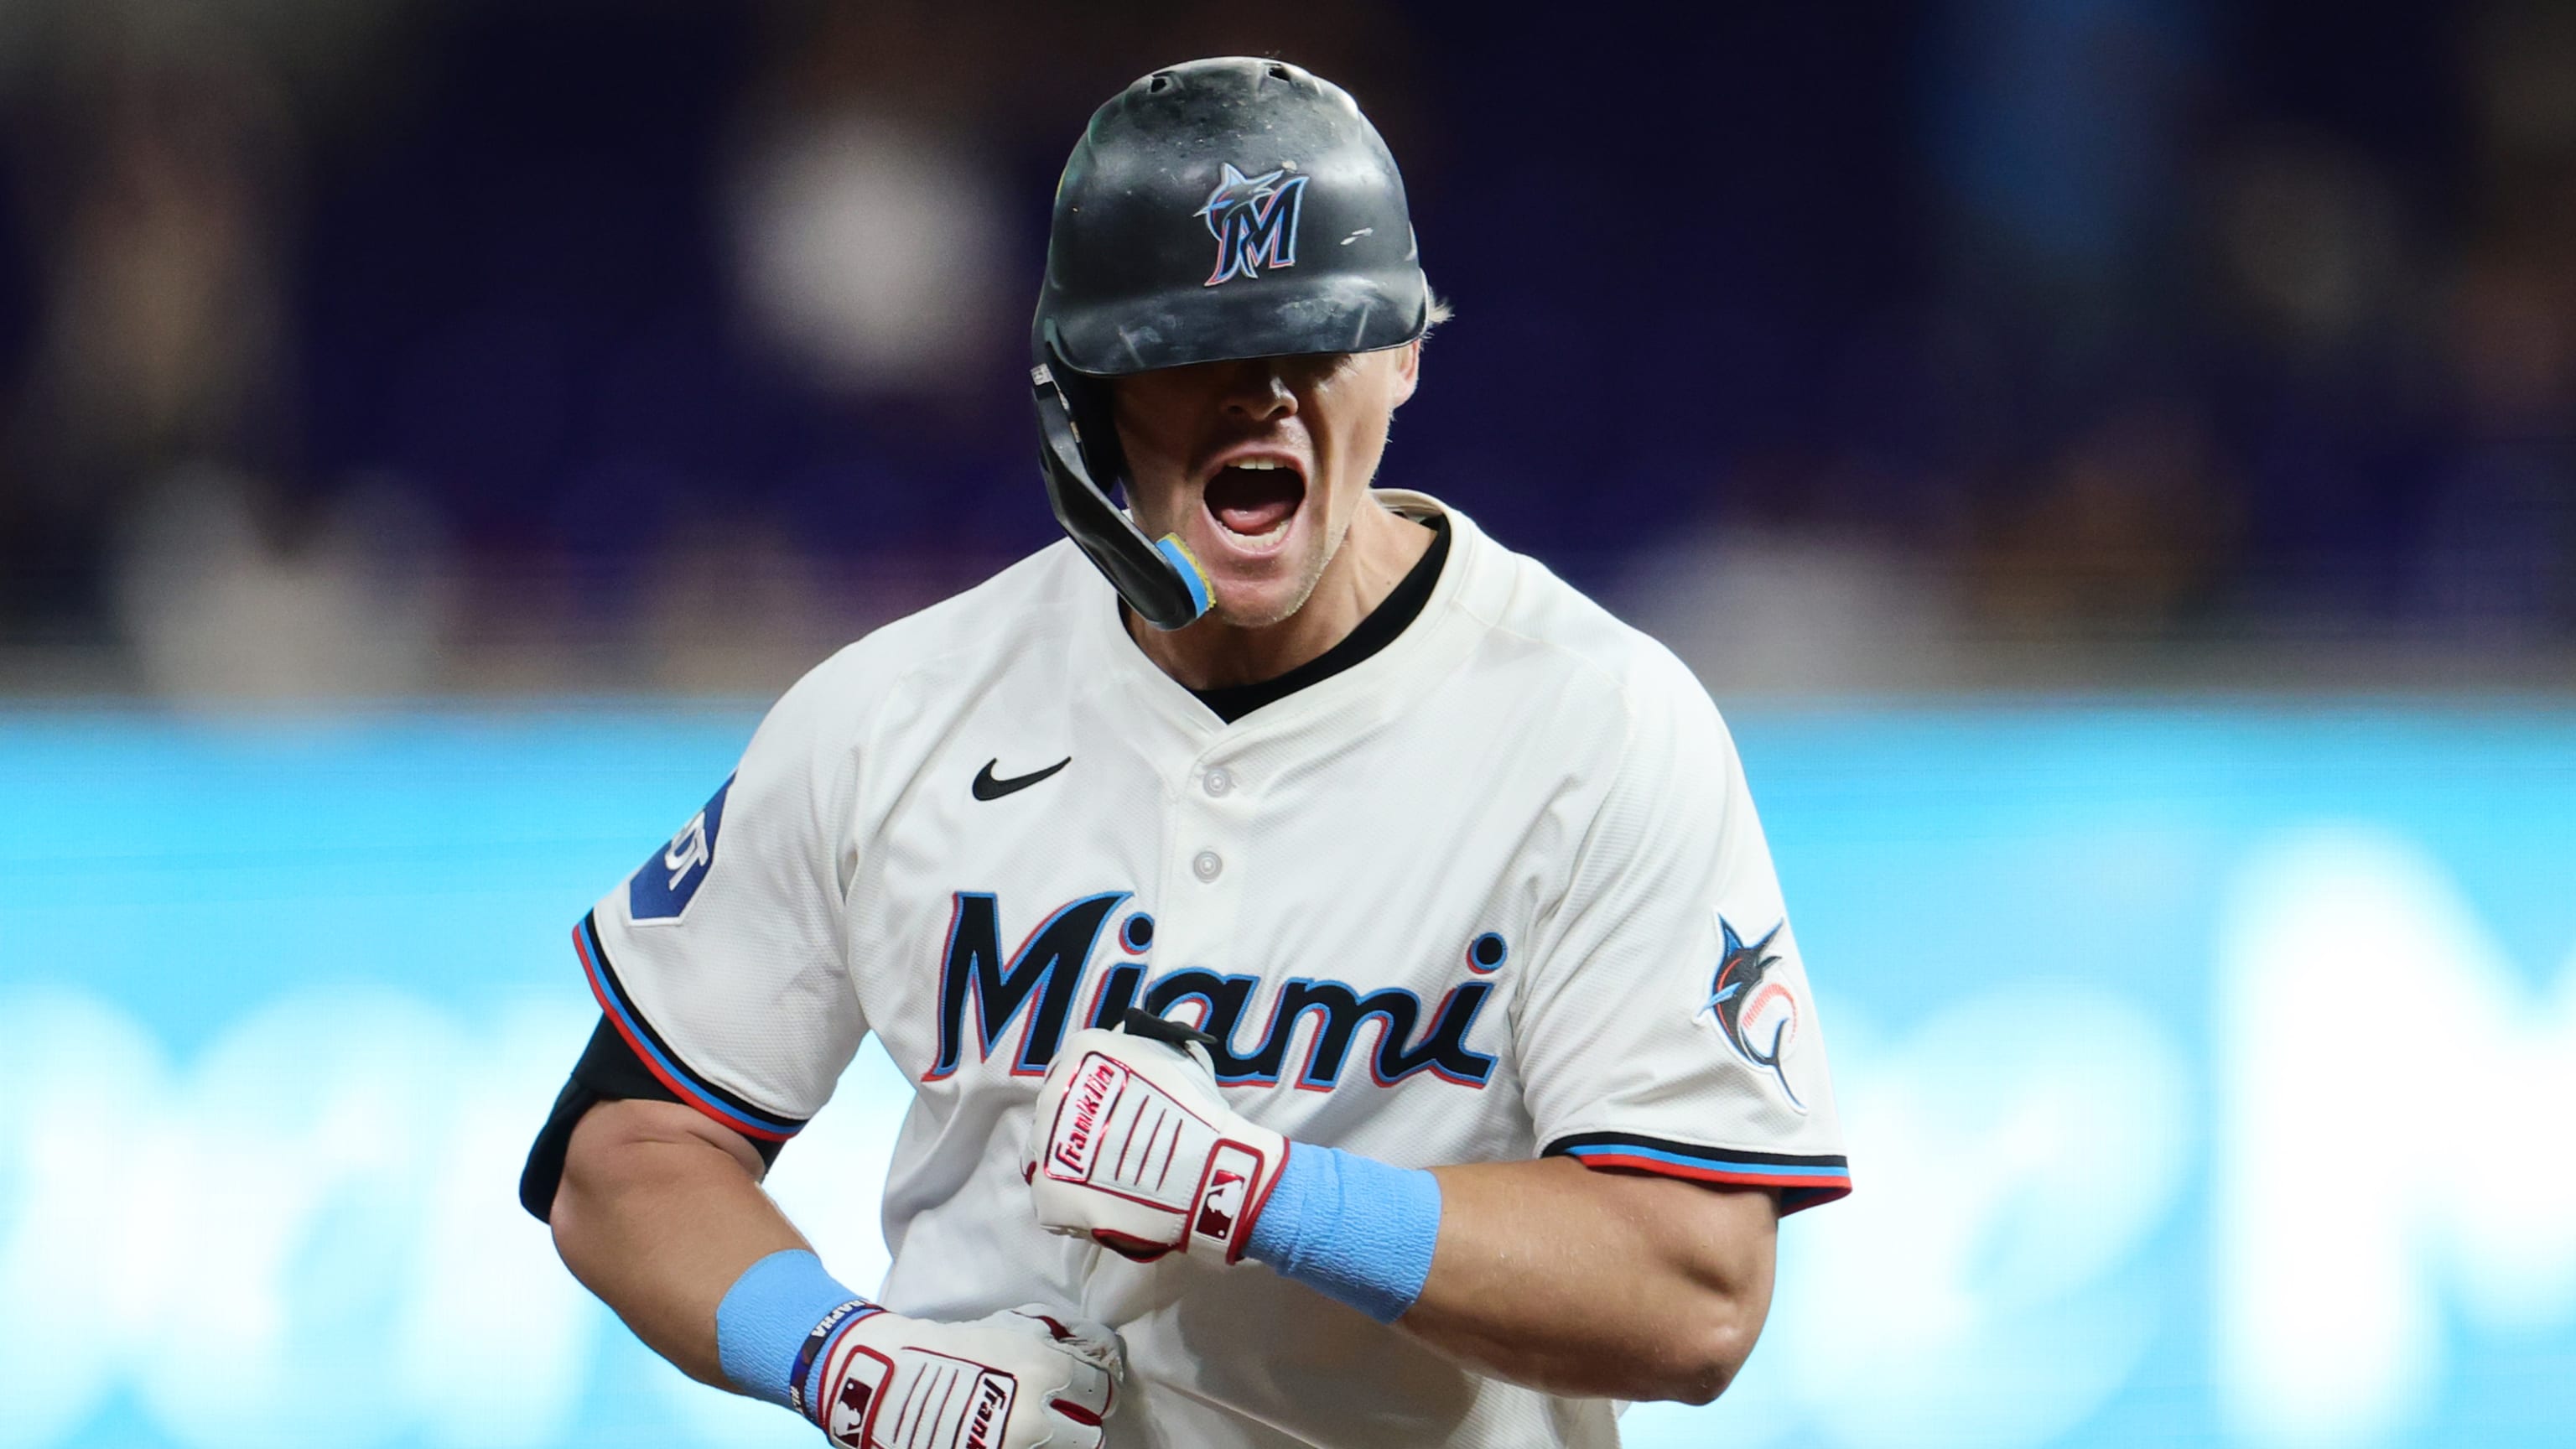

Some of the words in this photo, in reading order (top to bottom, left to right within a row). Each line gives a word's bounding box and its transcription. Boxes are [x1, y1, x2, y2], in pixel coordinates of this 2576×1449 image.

[665, 808, 709, 891] DT
[922, 891, 1507, 1093] Miami
[1055, 1063, 1115, 1174] Franklin
